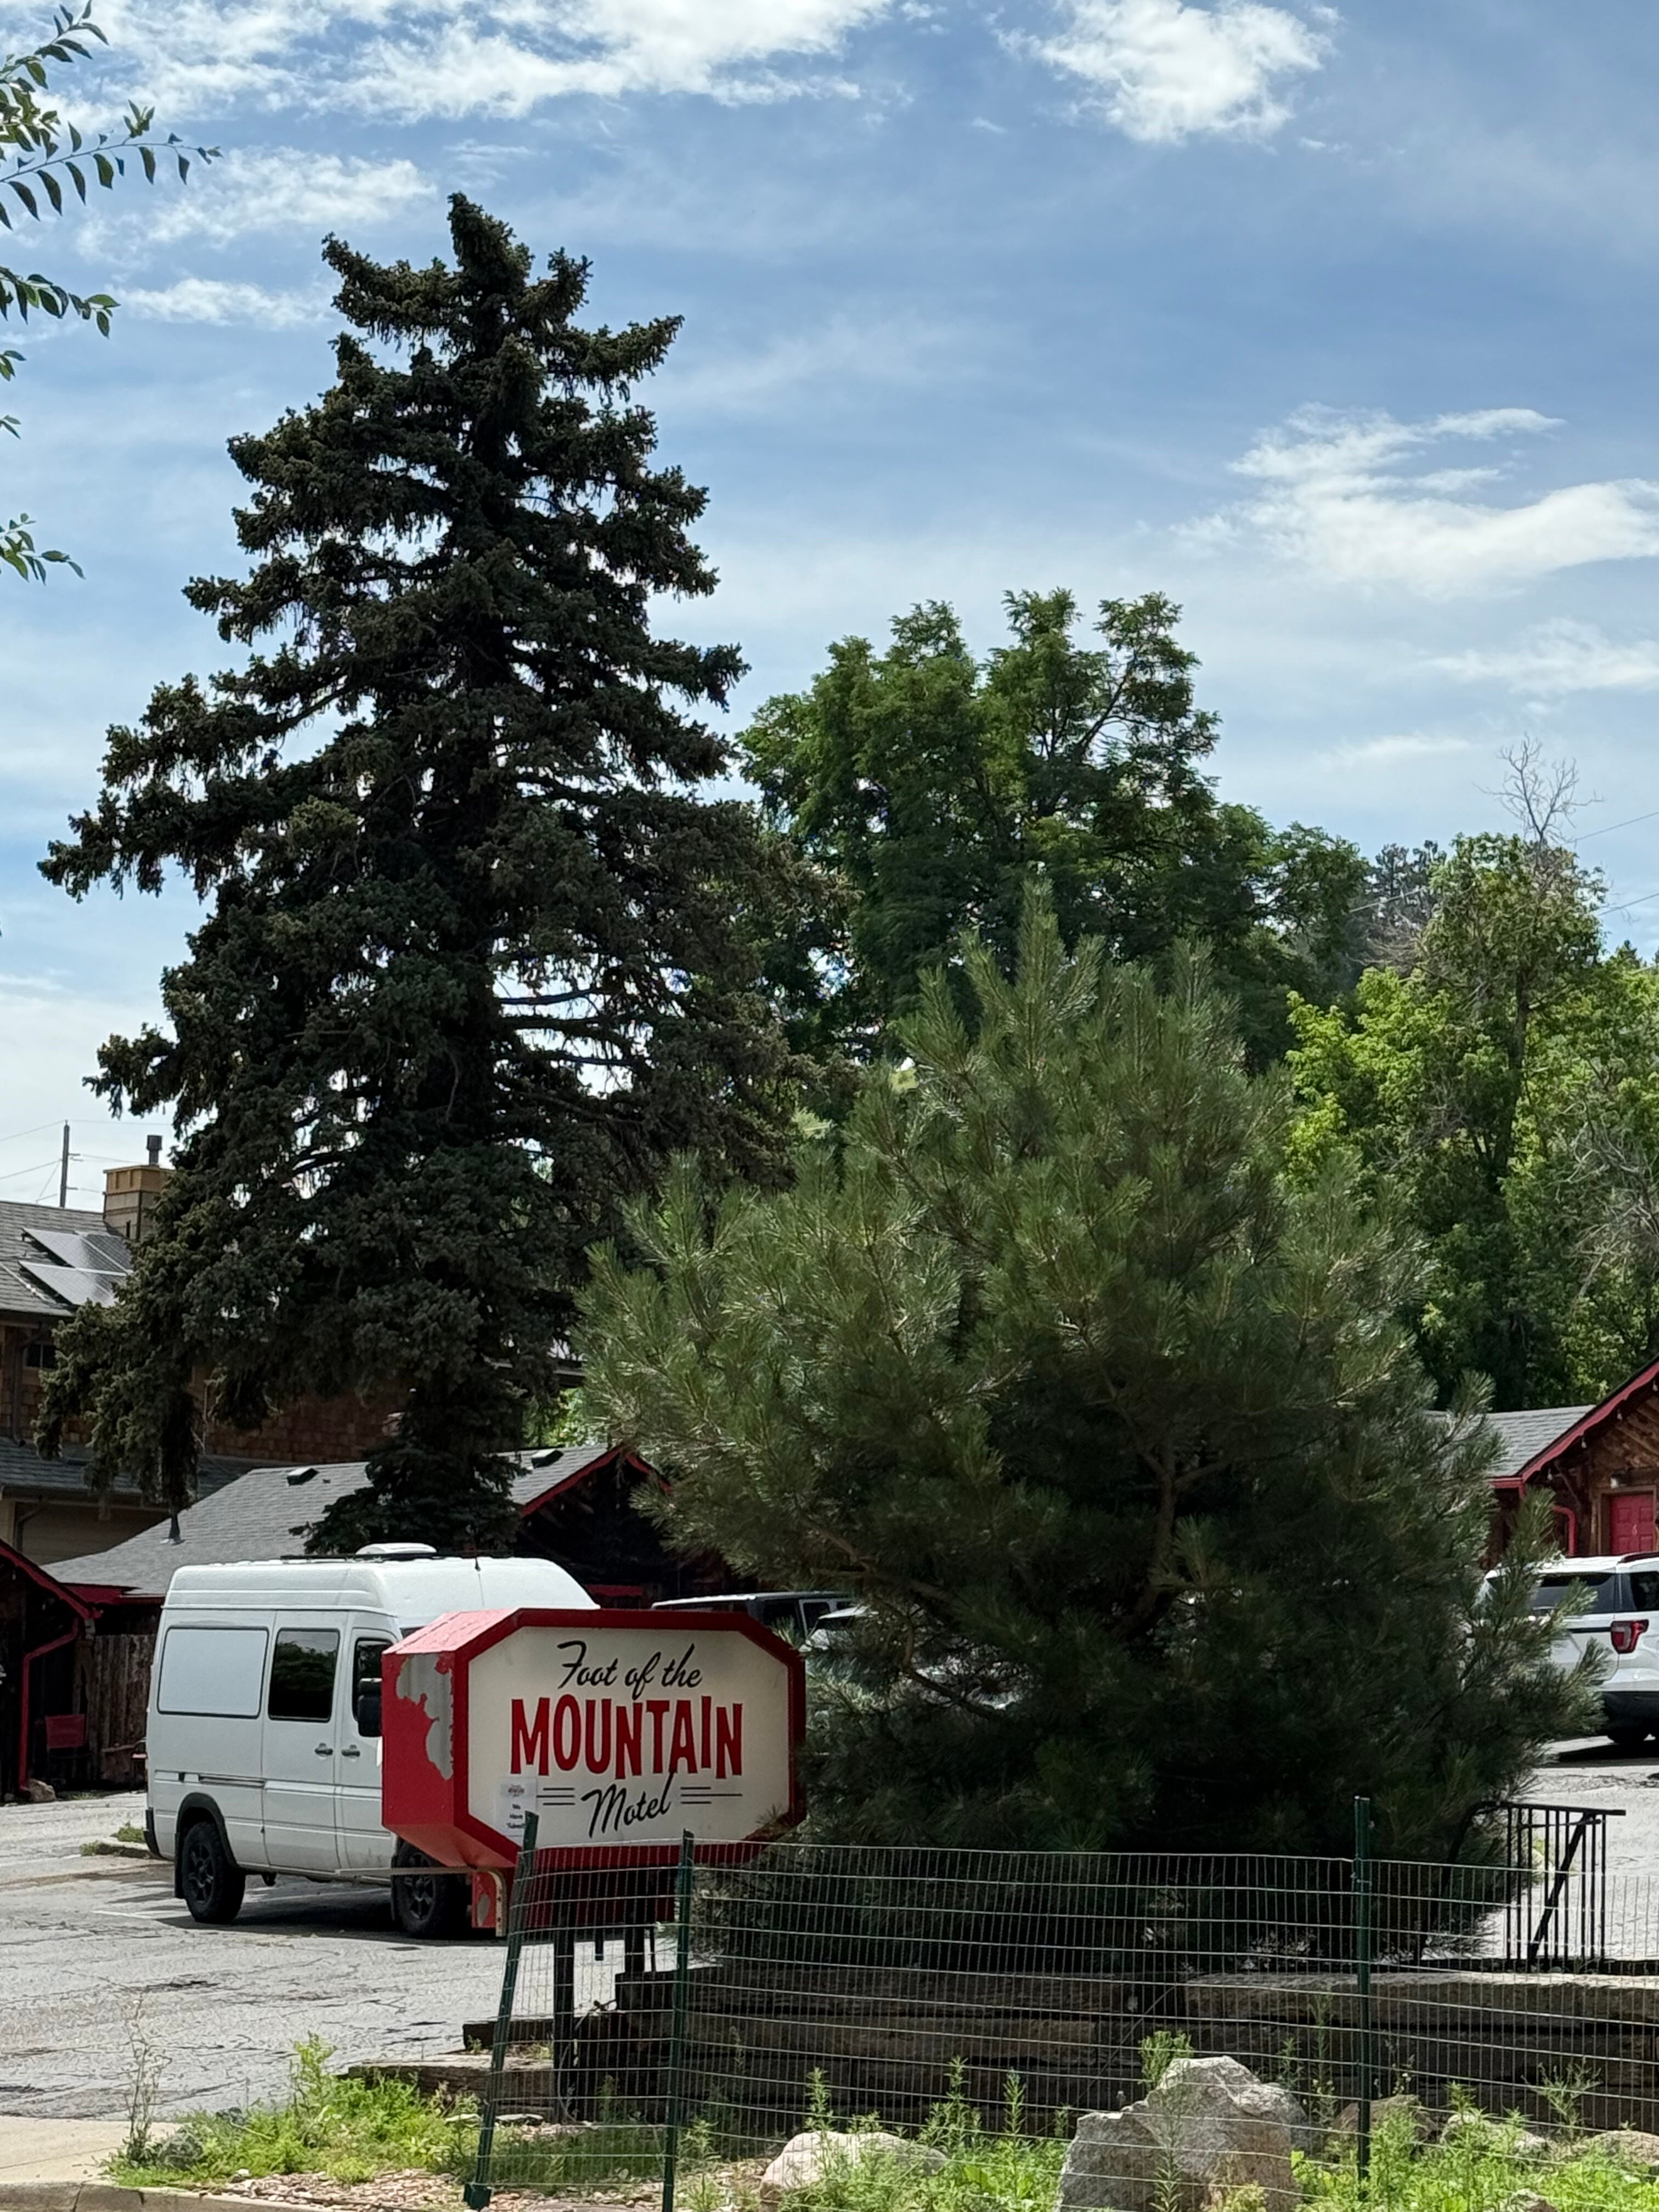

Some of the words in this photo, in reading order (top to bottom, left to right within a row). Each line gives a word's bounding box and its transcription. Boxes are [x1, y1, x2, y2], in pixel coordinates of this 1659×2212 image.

[557, 1640, 618, 1689] Foot
[625, 1651, 662, 1701] of
[661, 1643, 703, 1688] the
[510, 1694, 743, 1780] MOUNTAIN
[580, 1772, 672, 1839] Motel
